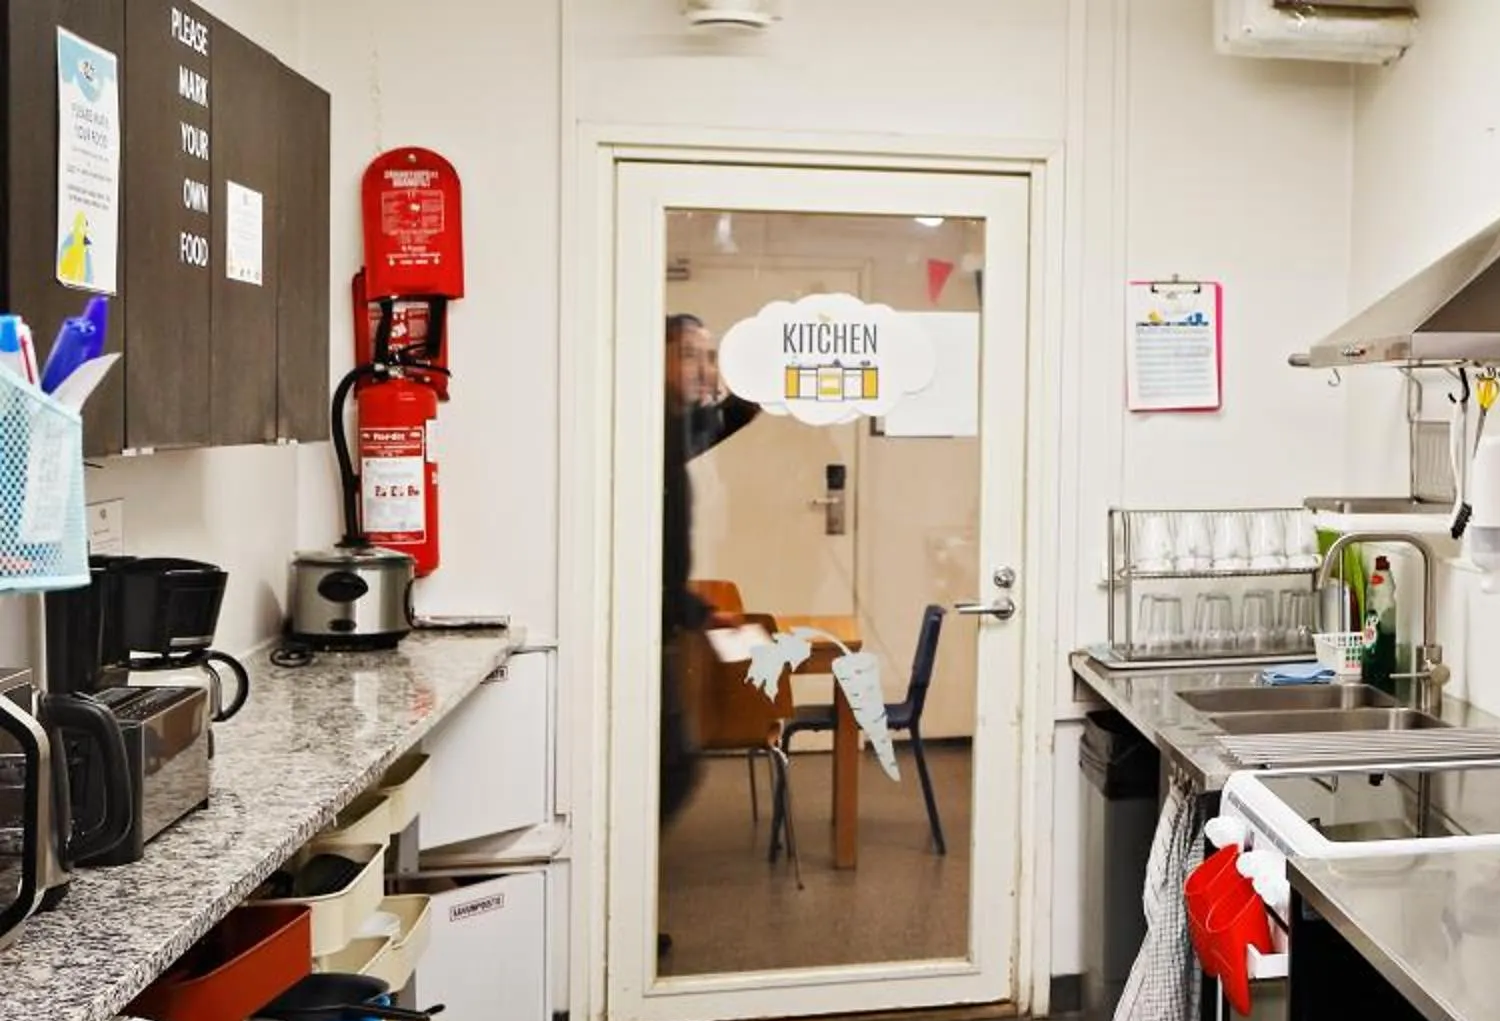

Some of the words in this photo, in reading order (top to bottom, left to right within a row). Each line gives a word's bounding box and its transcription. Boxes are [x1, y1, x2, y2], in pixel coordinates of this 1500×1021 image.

[171, 7, 208, 56] PLEASE
[179, 65, 208, 107] MARK
[180, 121, 208, 160] YOUR
[183, 178, 208, 214] OWN
[180, 232, 208, 267] FOOD
[783, 323, 877, 354] KITCHEN
